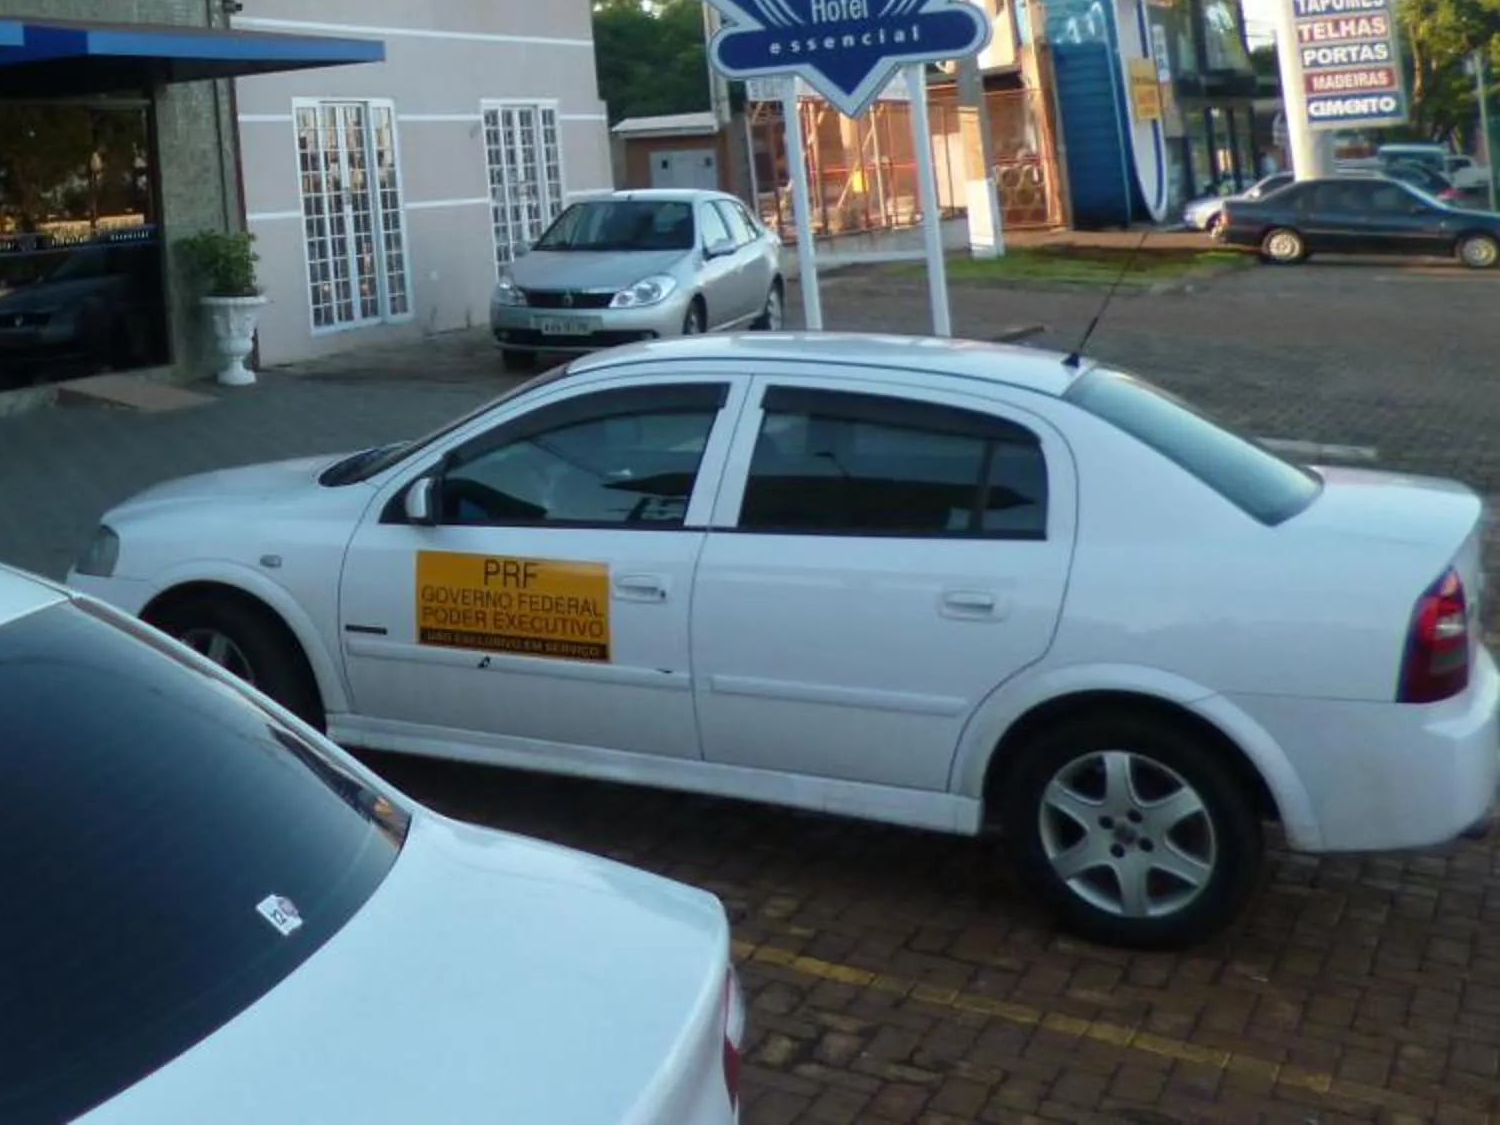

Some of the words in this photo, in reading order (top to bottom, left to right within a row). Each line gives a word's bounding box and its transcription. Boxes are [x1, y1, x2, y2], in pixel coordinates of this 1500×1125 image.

[770, 25, 920, 54] essencial
[1298, 16, 1387, 43] TELHAS
[1303, 43, 1389, 67] PORTAS
[1312, 70, 1389, 92] MADEIRAS
[1308, 95, 1397, 118] CIMENTO
[483, 558, 539, 589] PRF
[421, 584, 513, 610] GOVERNO
[518, 592, 604, 618] FEDERAL
[421, 605, 488, 629] PODER
[493, 610, 605, 638] EXECUTIVO
